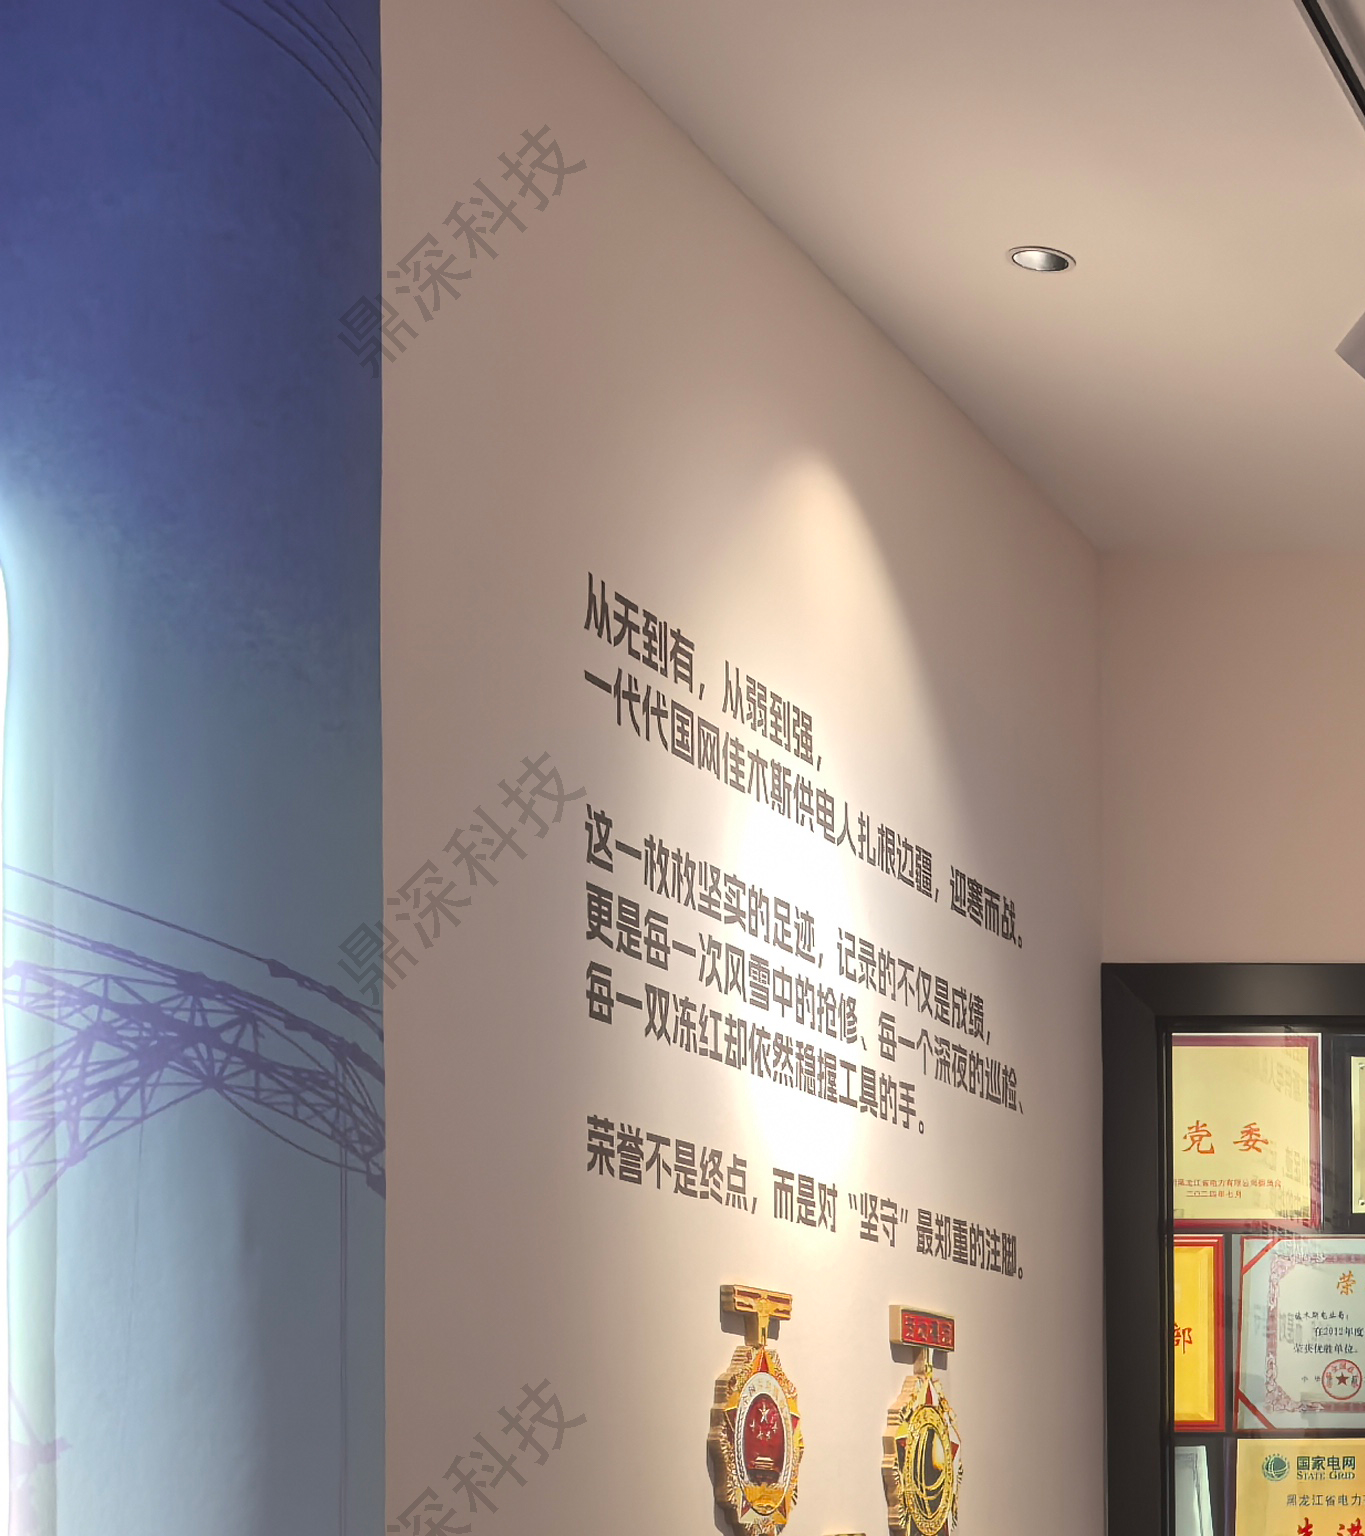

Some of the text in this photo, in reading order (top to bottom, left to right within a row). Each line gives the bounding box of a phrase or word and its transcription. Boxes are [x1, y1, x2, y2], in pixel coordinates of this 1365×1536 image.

[584, 572, 823, 773] 从无到有，从弱到强，
[584, 667, 1024, 950] 一代代国网佳木斯供电人扎根边疆，迎寒而战。
[585, 804, 992, 1045] 这一枚枚坚实的足迹，记录的不仅是成绩，
[585, 880, 1025, 1116] 更是每一次风雪中的抢修、每一个深夜的巡检、
[585, 961, 926, 1135] 每一双冻红却依然稳握工具的手。
[586, 1113, 1025, 1281] 荣誉不是终点，而是对“坚守”最郑重的注脚。
[1296, 1455, 1356, 1471] 国家电网
